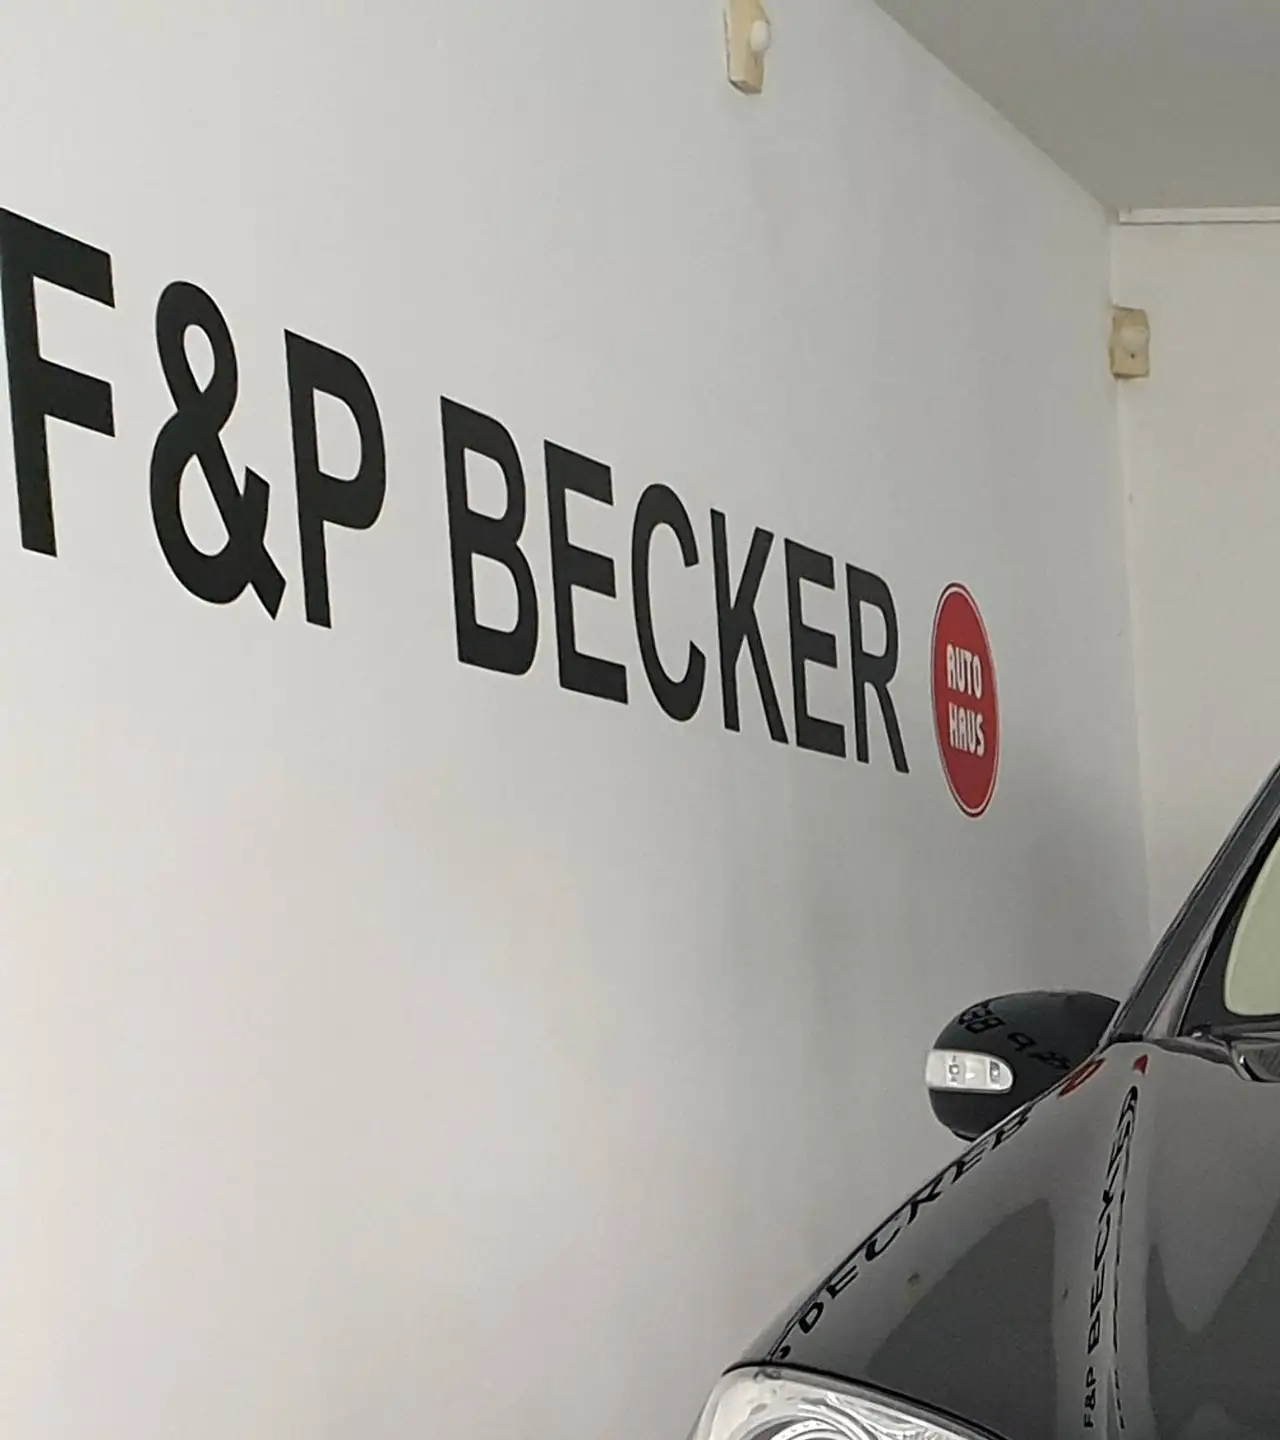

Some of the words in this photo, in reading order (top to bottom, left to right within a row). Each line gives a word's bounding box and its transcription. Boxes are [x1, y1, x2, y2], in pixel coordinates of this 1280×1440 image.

[439, 395, 910, 775] BECKER
[946, 643, 983, 699] AUTO
[948, 701, 985, 757] HAUS
